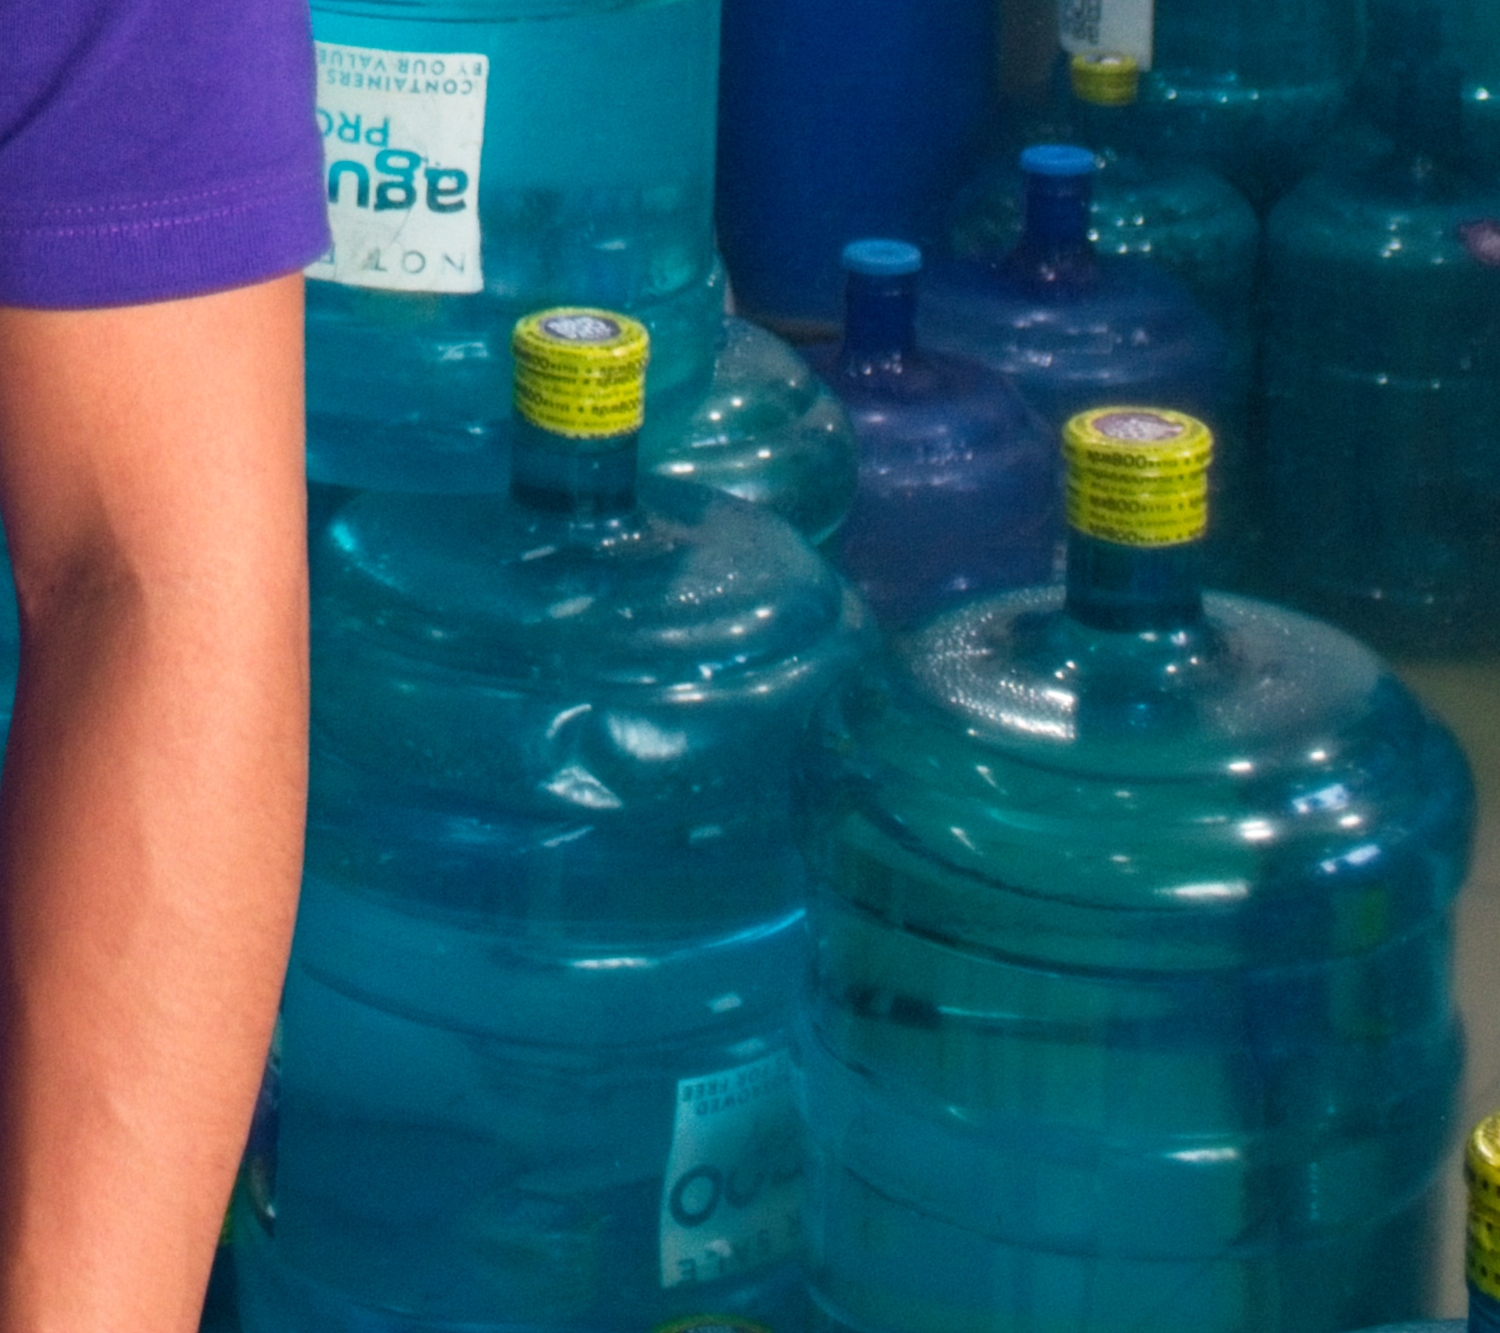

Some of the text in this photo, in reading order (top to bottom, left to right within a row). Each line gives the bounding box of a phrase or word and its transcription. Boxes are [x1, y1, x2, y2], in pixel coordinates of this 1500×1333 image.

[397, 59, 446, 76] OUR
[326, 69, 474, 96] CONTAINERS
[361, 248, 465, 274] NOT
